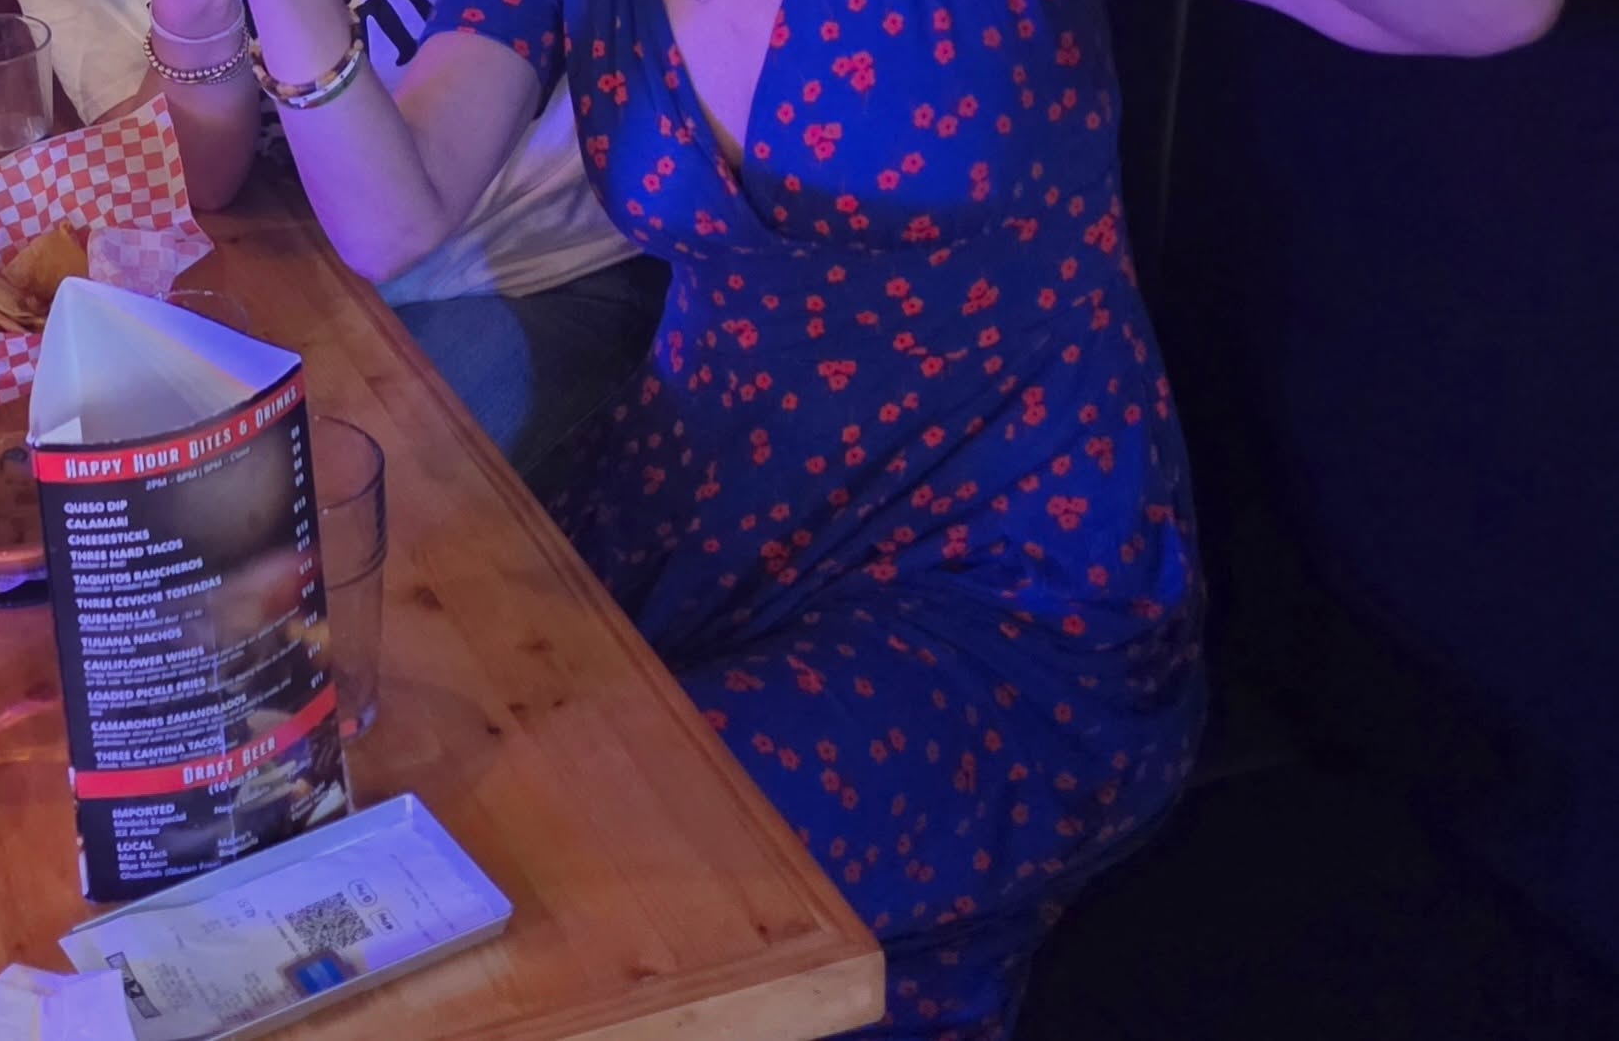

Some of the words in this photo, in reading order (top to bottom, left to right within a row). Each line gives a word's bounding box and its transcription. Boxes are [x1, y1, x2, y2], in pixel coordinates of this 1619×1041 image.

[65, 458, 122, 479] HAPPY
[133, 447, 179, 473] HOUR
[189, 429, 231, 459] BITES
[255, 385, 297, 428] DRINKS
[64, 501, 105, 514] QUESO
[107, 499, 128, 512] DIP
[66, 516, 129, 530] CALAMARI
[67, 529, 150, 546] CHEESESTICKS
[69, 549, 107, 562] THREE
[109, 546, 144, 559] HARD
[146, 538, 183, 555] TACOS
[73, 571, 131, 585] TAQUITOS
[133, 556, 204, 581] RANCHEROS
[75, 597, 113, 609] THREE
[115, 591, 163, 608] CEVICHE
[166, 574, 222, 601] TOSTADAS
[78, 608, 157, 625] QUESADILLAS
[81, 636, 131, 648] TIJUANA
[133, 627, 182, 645] NACHOS
[83, 654, 164, 671] CAULIFLOWER
[165, 646, 205, 662] WINGS
[87, 689, 134, 702] LOADED
[136, 683, 174, 698] PICKLE
[176, 676, 206, 692] FRIES
[91, 716, 164, 732] CAMARONES
[166, 693, 247, 725] ZARANDEADOS
[95, 749, 130, 762] THREE
[133, 742, 185, 759] CANTINA
[187, 735, 223, 751] TACOS
[183, 758, 233, 785] DRAFT
[242, 737, 276, 767] BEER
[112, 804, 175, 818] IMPORTED
[117, 840, 155, 852] LOCAL
